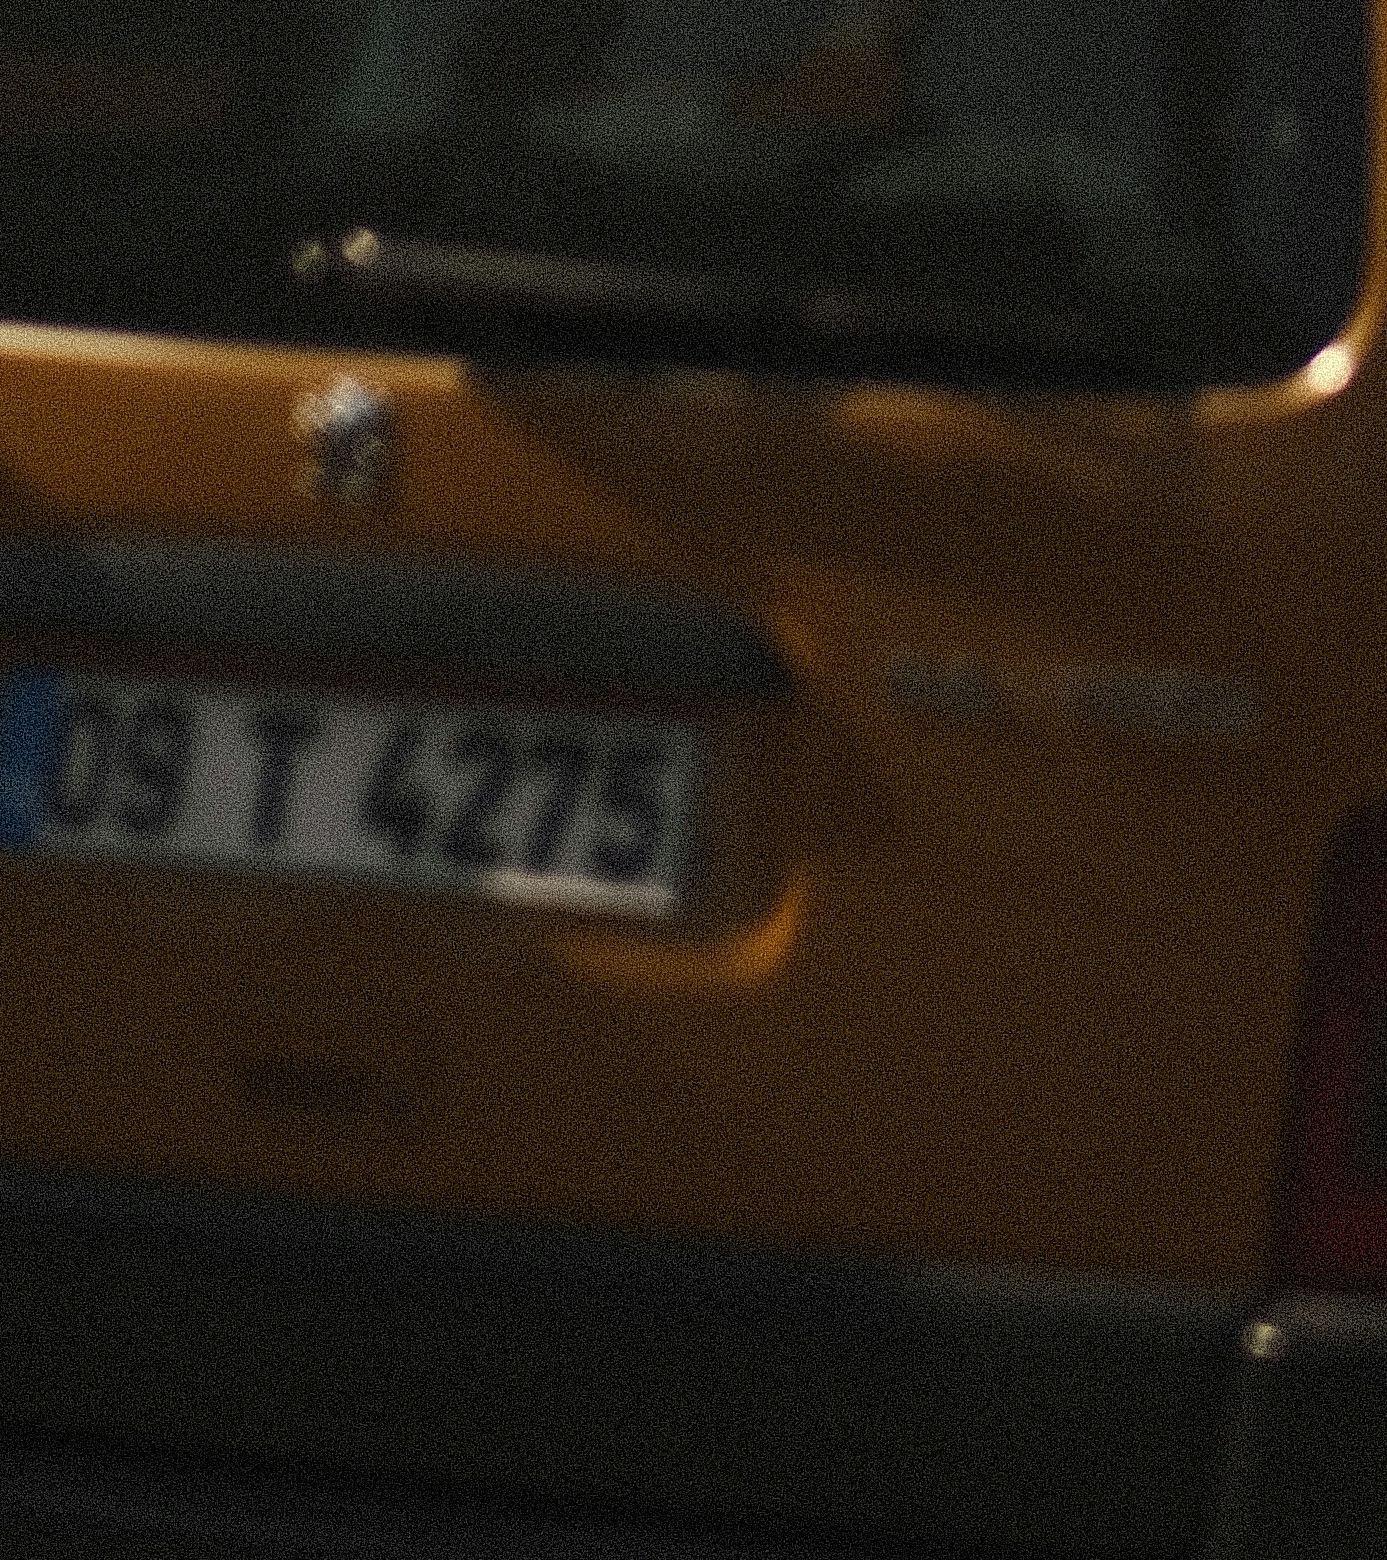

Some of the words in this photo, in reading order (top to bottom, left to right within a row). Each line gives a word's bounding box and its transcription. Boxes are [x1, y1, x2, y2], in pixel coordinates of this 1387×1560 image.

[49, 693, 192, 835] 09
[250, 704, 319, 846] T
[360, 722, 668, 880] 4275
